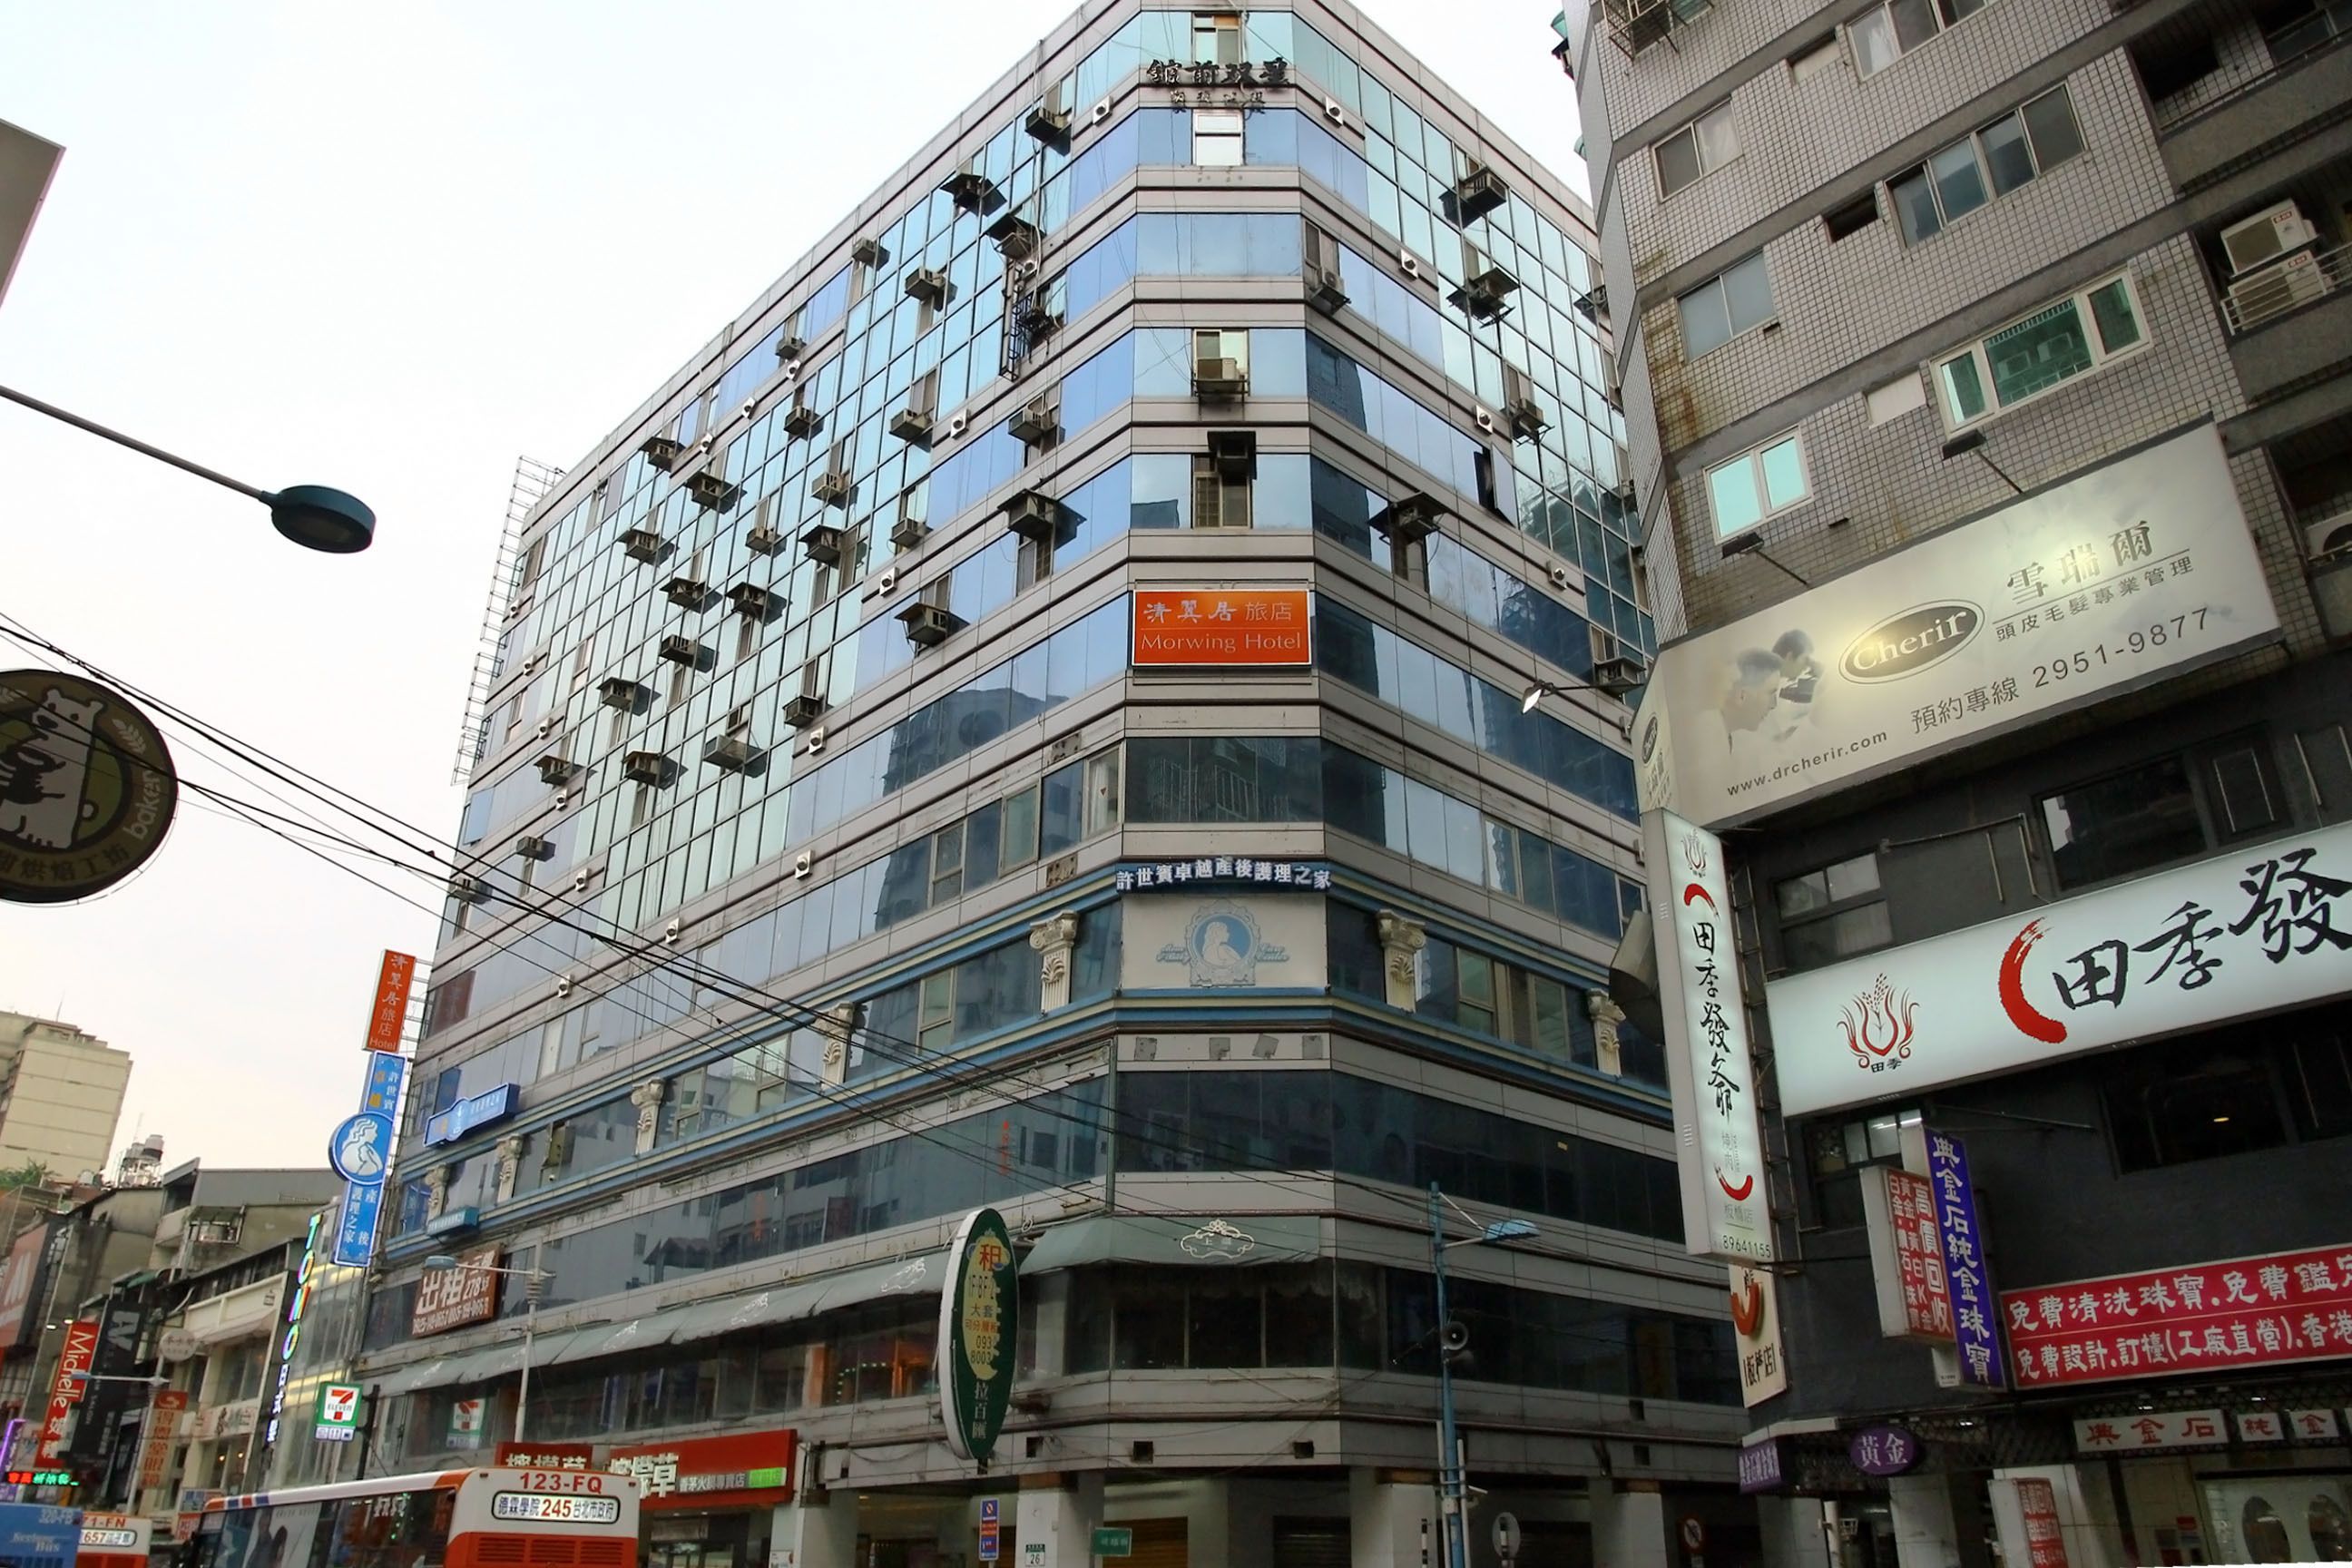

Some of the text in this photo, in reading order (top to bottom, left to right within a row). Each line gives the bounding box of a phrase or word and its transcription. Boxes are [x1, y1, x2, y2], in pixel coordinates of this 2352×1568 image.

[2007, 519, 2153, 605] 雪瑞爾
[1996, 555, 2194, 642] 頭皮毛髮專業管理
[1142, 632, 1301, 653] Morwing Hotel
[1853, 611, 1967, 671] Cherir
[1911, 607, 2209, 735] 預約專線 2951-9877
[1727, 730, 1887, 797] www.drcherir.com
[1116, 858, 1332, 891] 許世賓卓越產後護理之家
[2052, 848, 2352, 1009] 田季發
[368, 1037, 397, 1051] Hotel
[1870, 1058, 1902, 1073] 田季
[979, 1244, 1002, 1271] 租
[1722, 1235, 1772, 1259] 89641155
[1913, 1181, 1952, 1334] 高價回收
[1932, 1136, 1991, 1384] 典金石純金珠寶
[416, 1262, 466, 1315] 出租
[53, 1330, 95, 1408] Michelle
[331, 1389, 354, 1420] 7
[2086, 1414, 2328, 1446] 典金石 純 金
[1857, 1433, 1908, 1467] 黃金
[520, 1472, 603, 1494] 123-FQ
[498, 1496, 614, 1520] 德霖學院 245 台北市政府
[84, 1532, 106, 1544] 657
